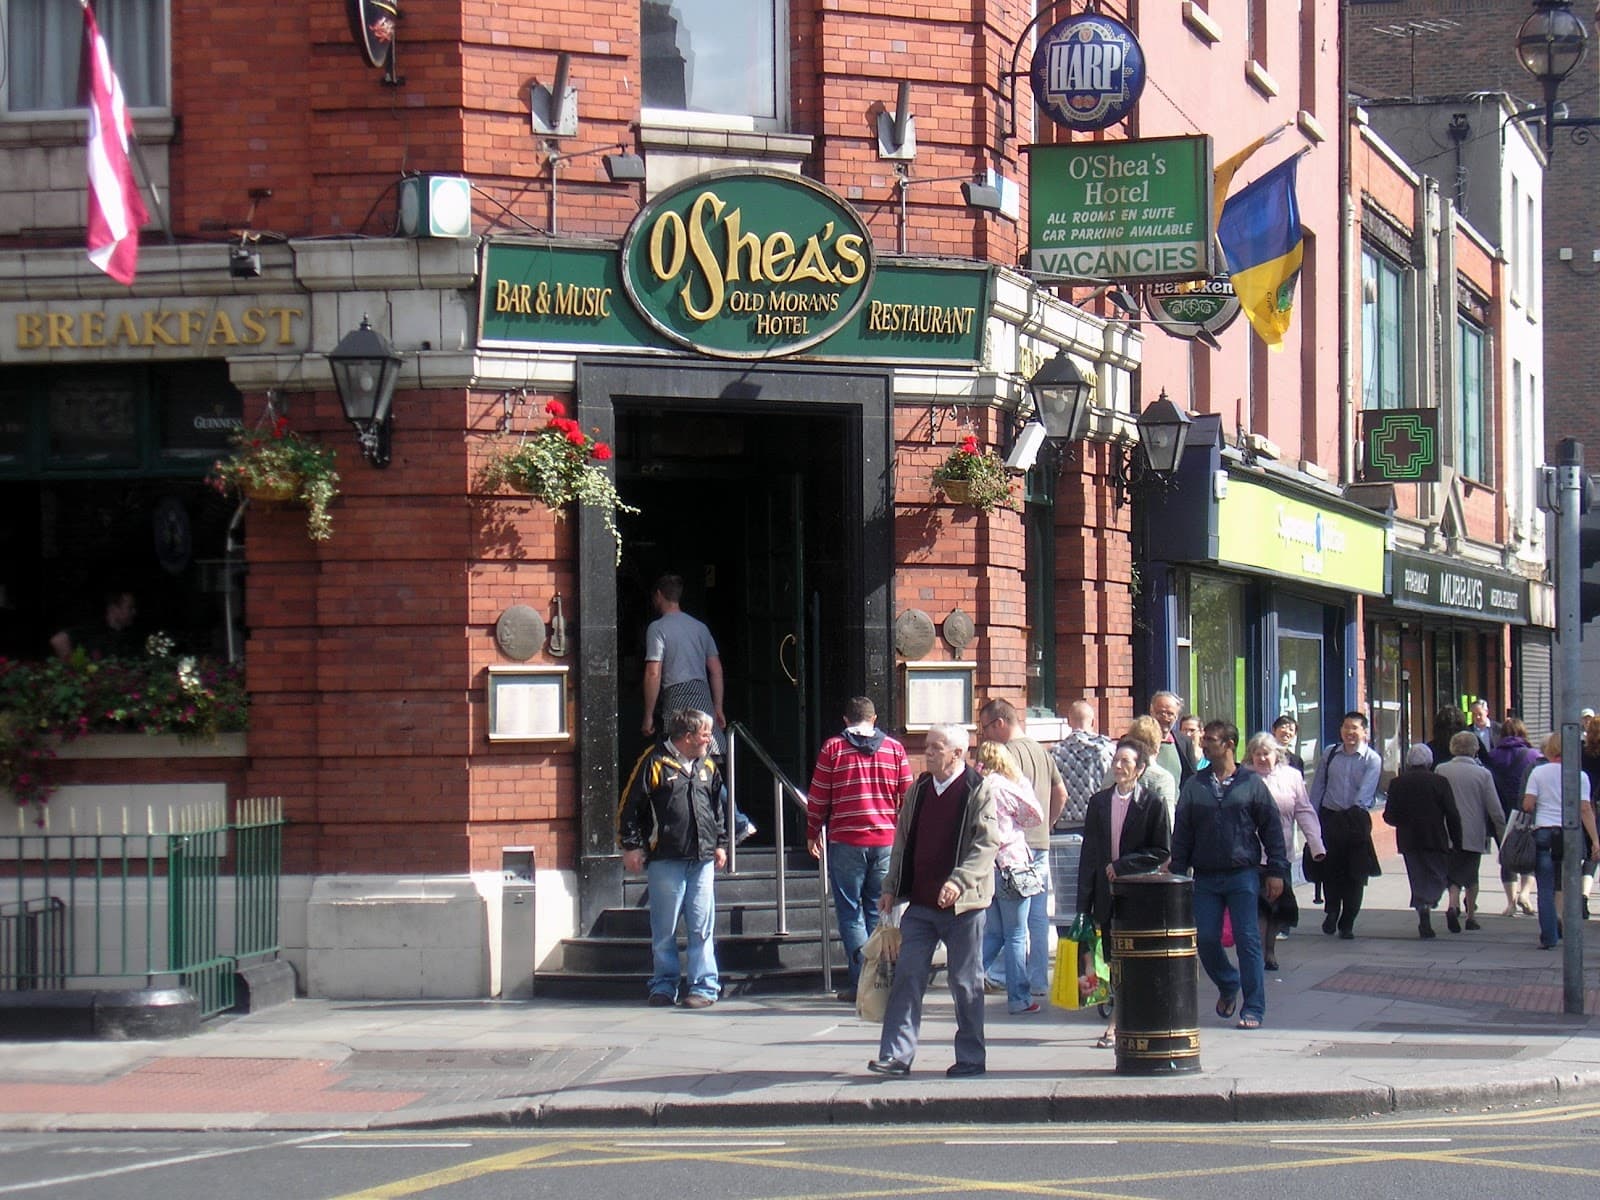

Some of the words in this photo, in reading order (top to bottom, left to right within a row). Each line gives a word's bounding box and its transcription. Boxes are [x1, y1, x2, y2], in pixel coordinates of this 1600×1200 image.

[1050, 43, 1121, 91] HARP
[1069, 152, 1166, 179] O'Shea's
[1084, 180, 1149, 205] Hotel
[1047, 212, 1067, 224] ALL
[1072, 210, 1116, 224] ROOMS
[1121, 209, 1138, 221] EN
[1141, 207, 1176, 220] SUITE
[1042, 229, 1066, 242] CAR
[1070, 227, 1124, 240] PARKING
[1129, 223, 1194, 237] AVAILABLE
[1039, 247, 1198, 276] VACANCIES
[496, 279, 532, 314] BAR
[535, 281, 551, 314] &
[555, 282, 613, 317] MUSIC
[730, 290, 764, 312] OLD
[769, 290, 840, 312] MORANS
[15, 308, 302, 349] BREAKFAST
[757, 314, 810, 335] HOTEL
[869, 299, 976, 334] RESTAURANT
